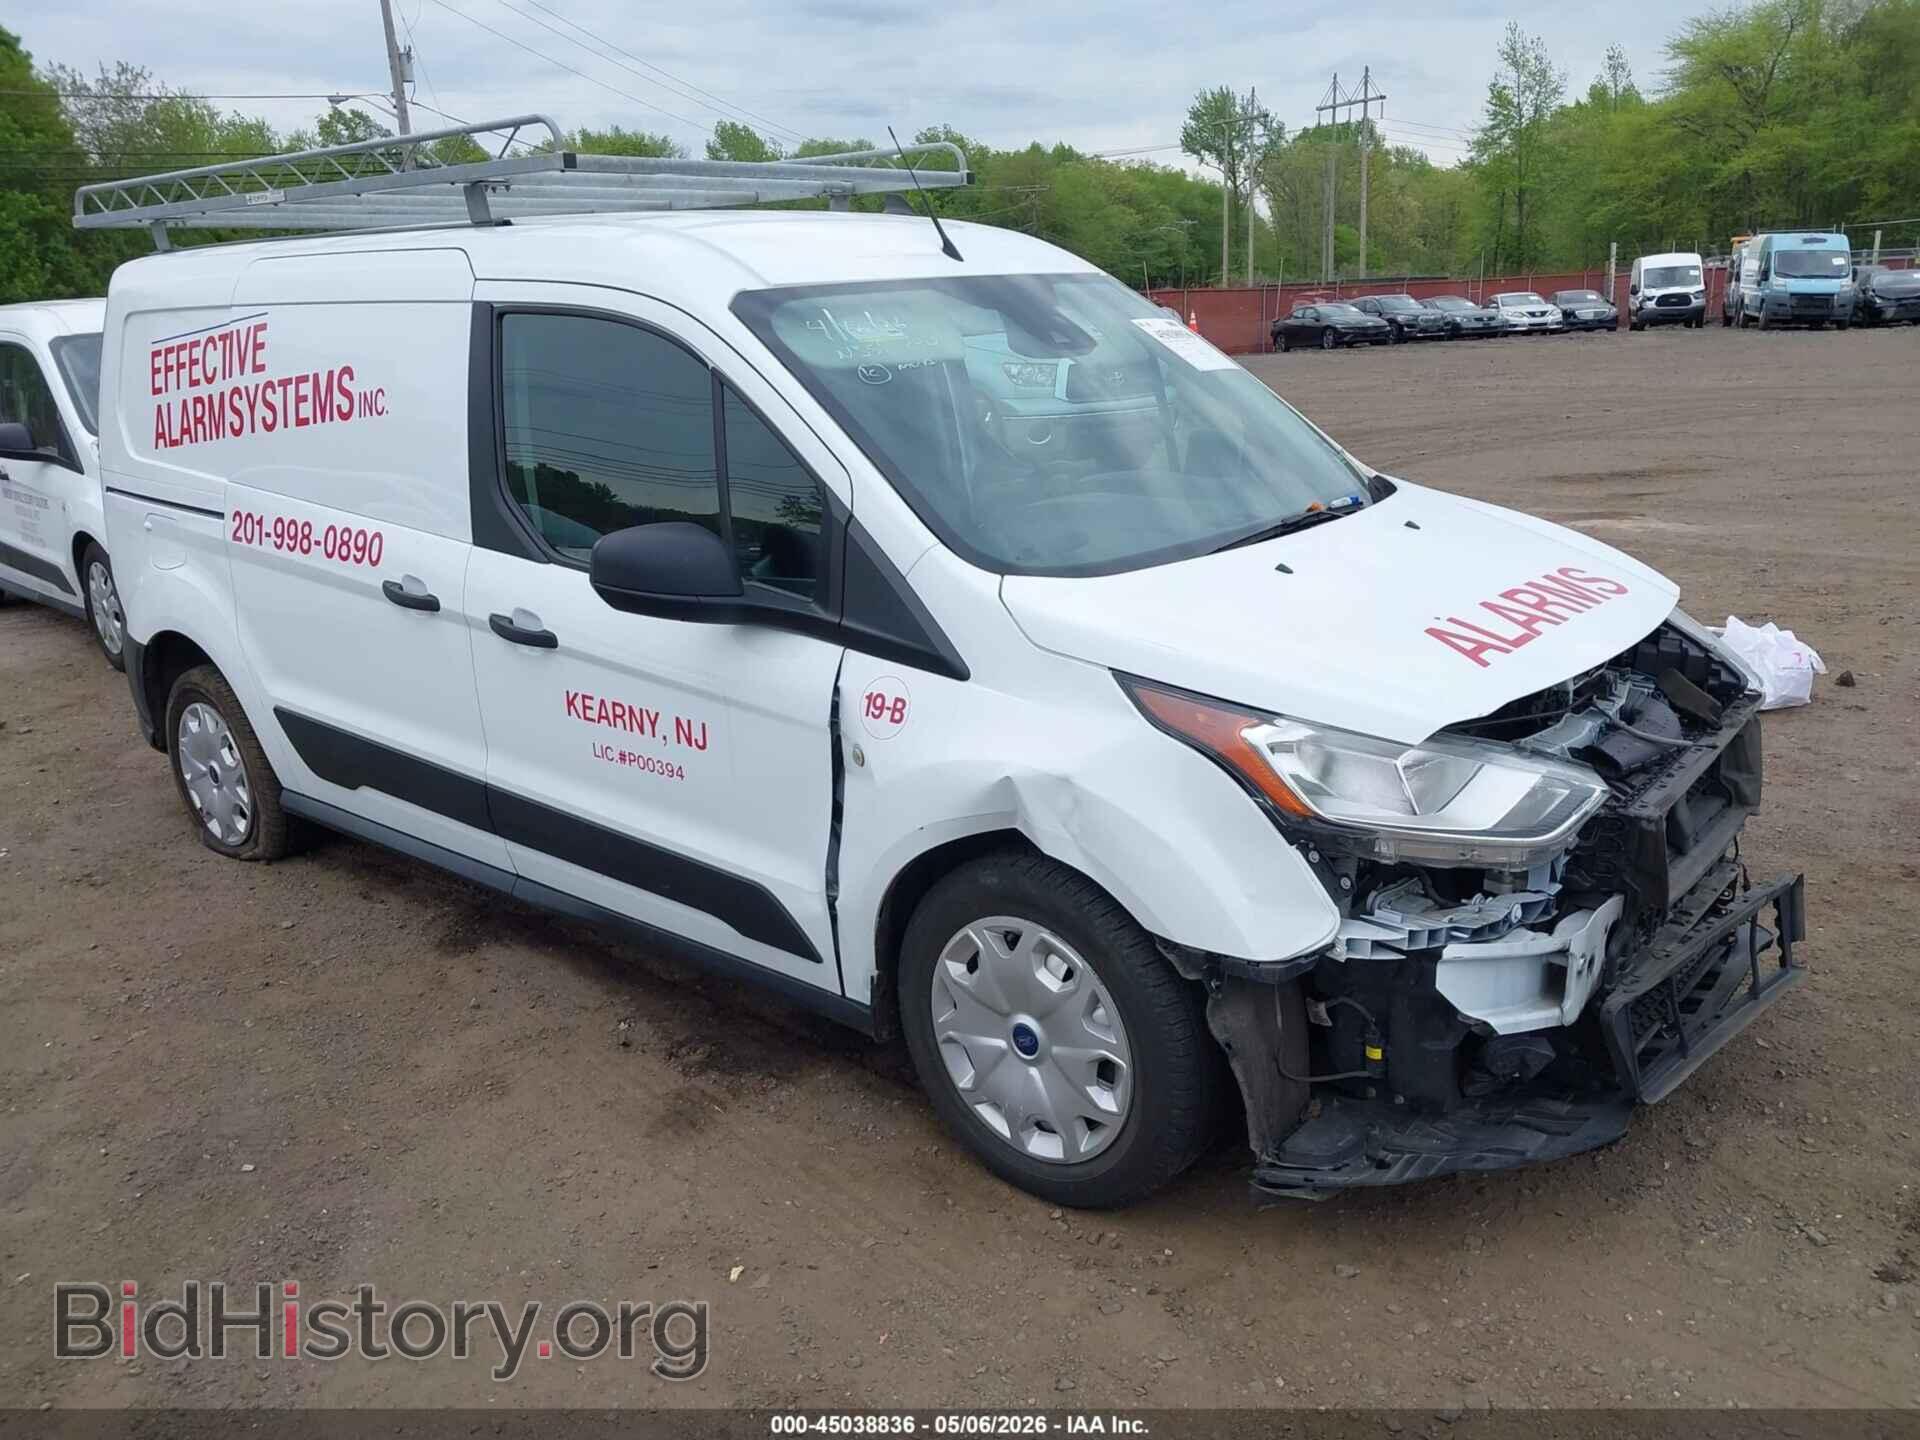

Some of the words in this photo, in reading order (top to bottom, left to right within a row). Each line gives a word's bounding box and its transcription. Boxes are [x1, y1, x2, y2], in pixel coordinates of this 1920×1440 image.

[151, 322, 268, 396] EFFECTIVE
[358, 388, 389, 418] INC.
[231, 510, 384, 567] 201-998-0890
[1423, 567, 1629, 668] ALARMS
[565, 690, 668, 747] KEARNY,
[675, 716, 708, 752] NJ
[864, 691, 907, 725] 19-B
[592, 741, 686, 781] LIC.#P00394
